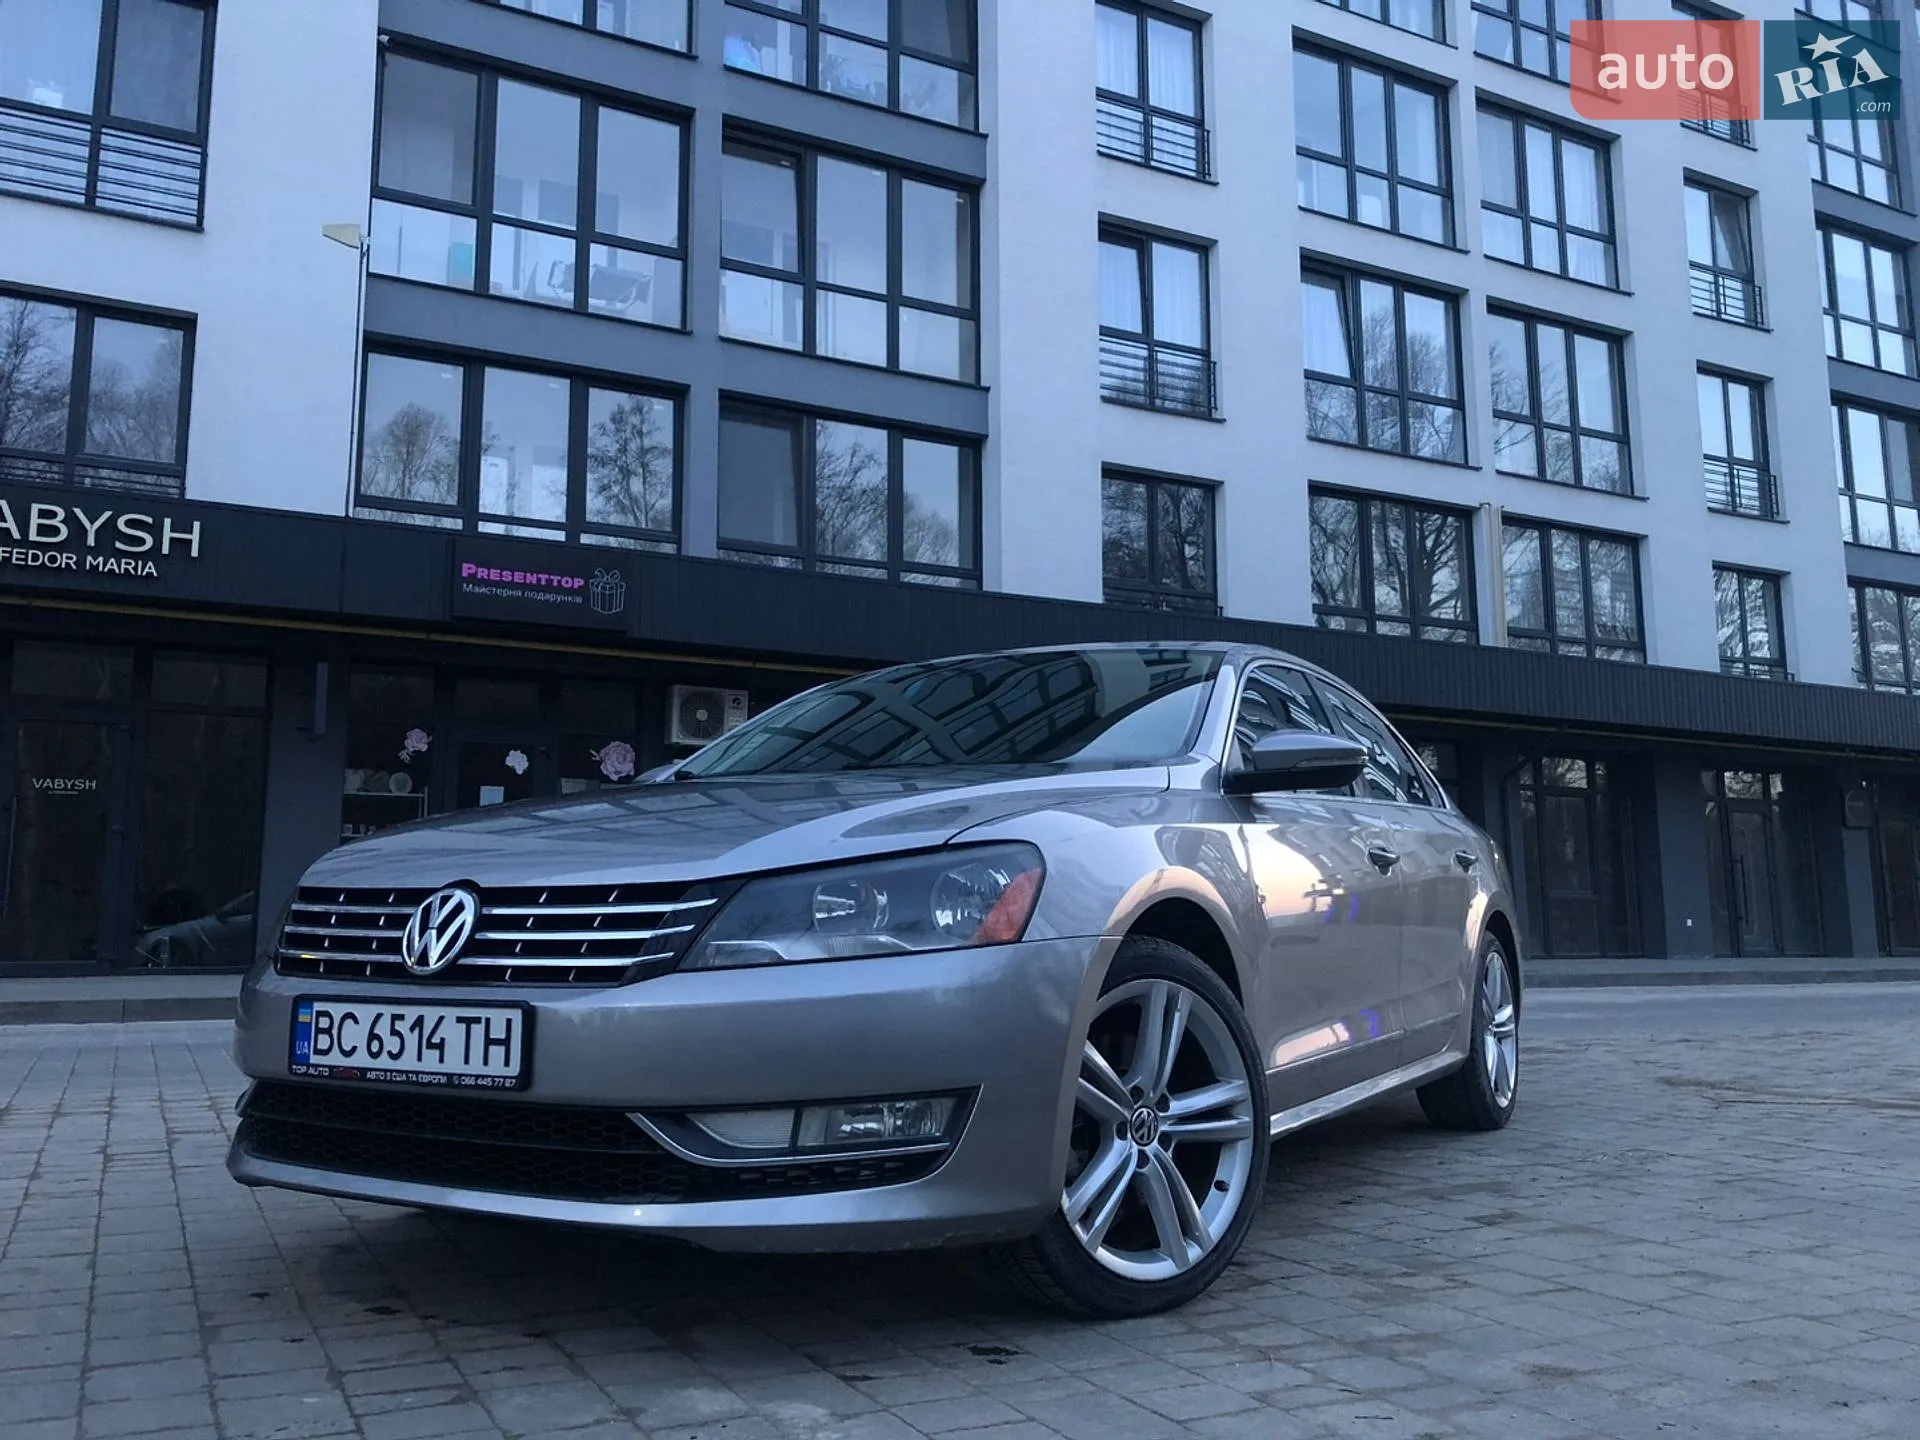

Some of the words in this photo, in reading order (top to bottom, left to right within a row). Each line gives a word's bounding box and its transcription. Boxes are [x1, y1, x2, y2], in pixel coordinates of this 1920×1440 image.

[0, 547, 77, 570] FEDOR
[86, 555, 158, 577] MARIA
[462, 583, 523, 598] Майстерня
[524, 590, 583, 604] подарунків
[32, 778, 97, 790] VABYSH
[296, 1041, 310, 1055] UA
